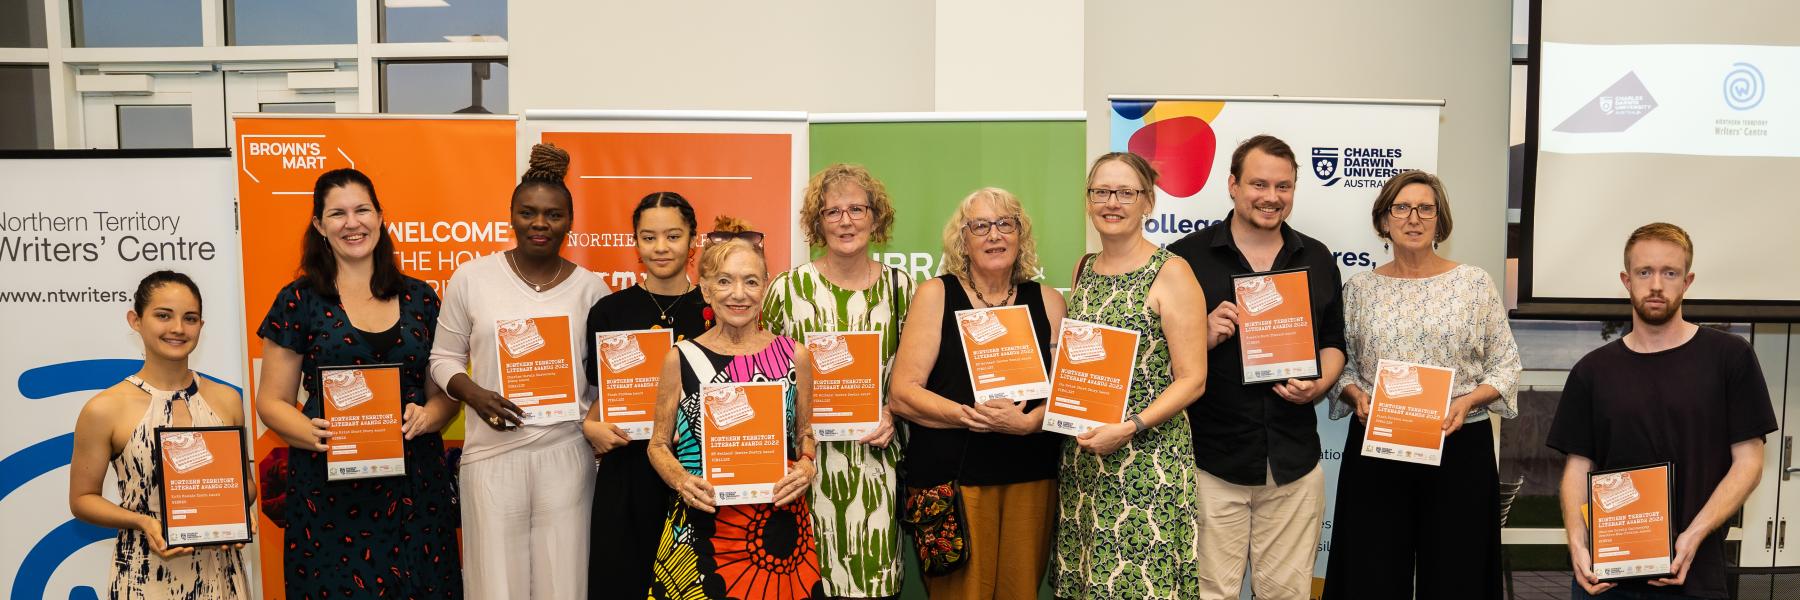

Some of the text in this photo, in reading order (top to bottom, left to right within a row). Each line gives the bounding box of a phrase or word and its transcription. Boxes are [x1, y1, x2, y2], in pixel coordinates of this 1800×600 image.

[250, 142, 320, 156] BROWN'S
[1344, 148, 1402, 158] CHARLES
[282, 156, 326, 169] MART
[1344, 158, 1394, 167] DARWIN
[1344, 180, 1386, 188] AUSTRA
[93, 211, 180, 235] Territory
[567, 232, 636, 247] NORTHE
[118, 235, 216, 262] Centre
[393, 251, 432, 271] HE
[0, 287, 137, 303] www.ntwriters.
[1060, 368, 1120, 384] NORTHERN TERRITORY
[1060, 374, 1087, 383] LITERARY
[1408, 406, 1438, 415] TERRITORY
